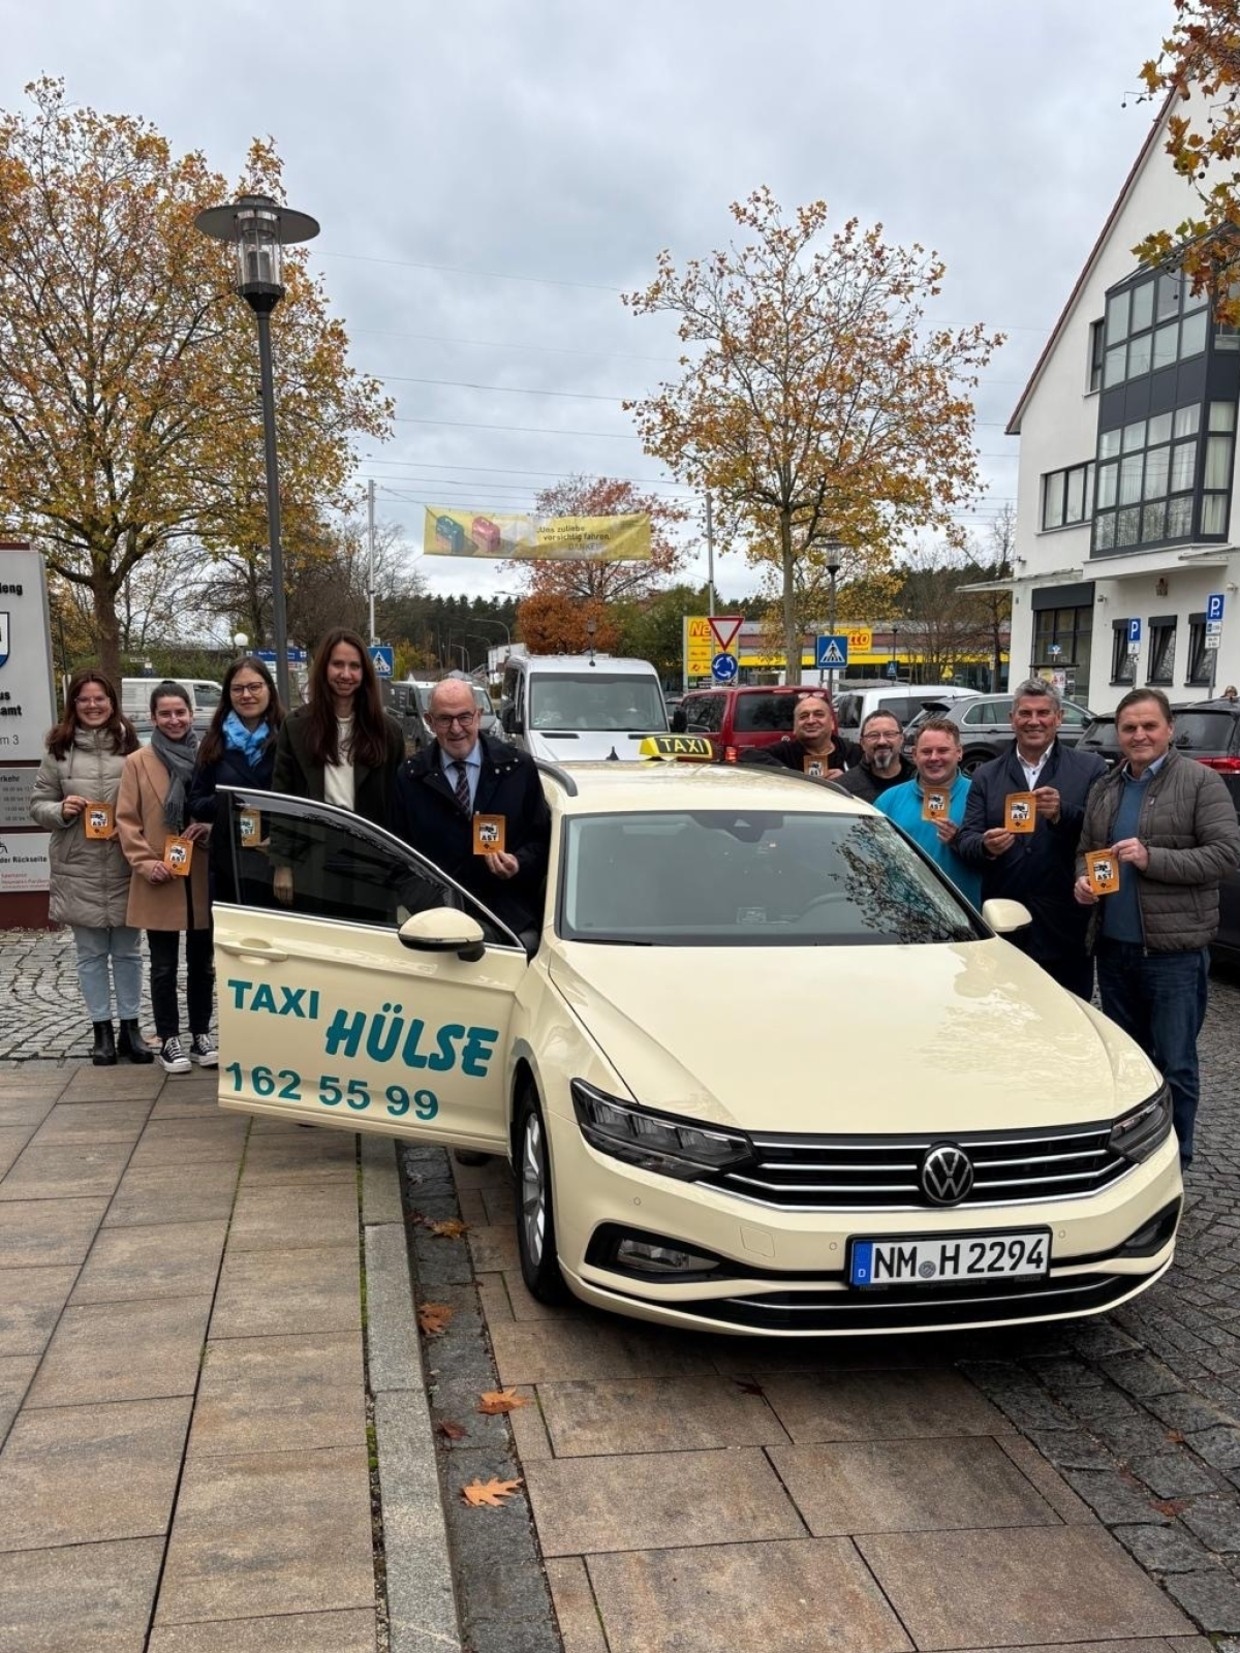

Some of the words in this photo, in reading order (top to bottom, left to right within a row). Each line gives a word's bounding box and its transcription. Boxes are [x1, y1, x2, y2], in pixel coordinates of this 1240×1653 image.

[557, 525, 585, 533] zuliebe
[12, 734, 19, 746] 3
[659, 738, 704, 753] TAXI
[228, 979, 320, 1019] TAXI
[325, 1002, 499, 1077] HÜLSE
[225, 1062, 302, 1101] 162
[319, 1075, 371, 1110] 55
[385, 1085, 439, 1121] 99
[858, 1268, 867, 1278] D
[873, 1246, 918, 1279] NM
[939, 1243, 961, 1276] H
[967, 1238, 1044, 1274] 2294
